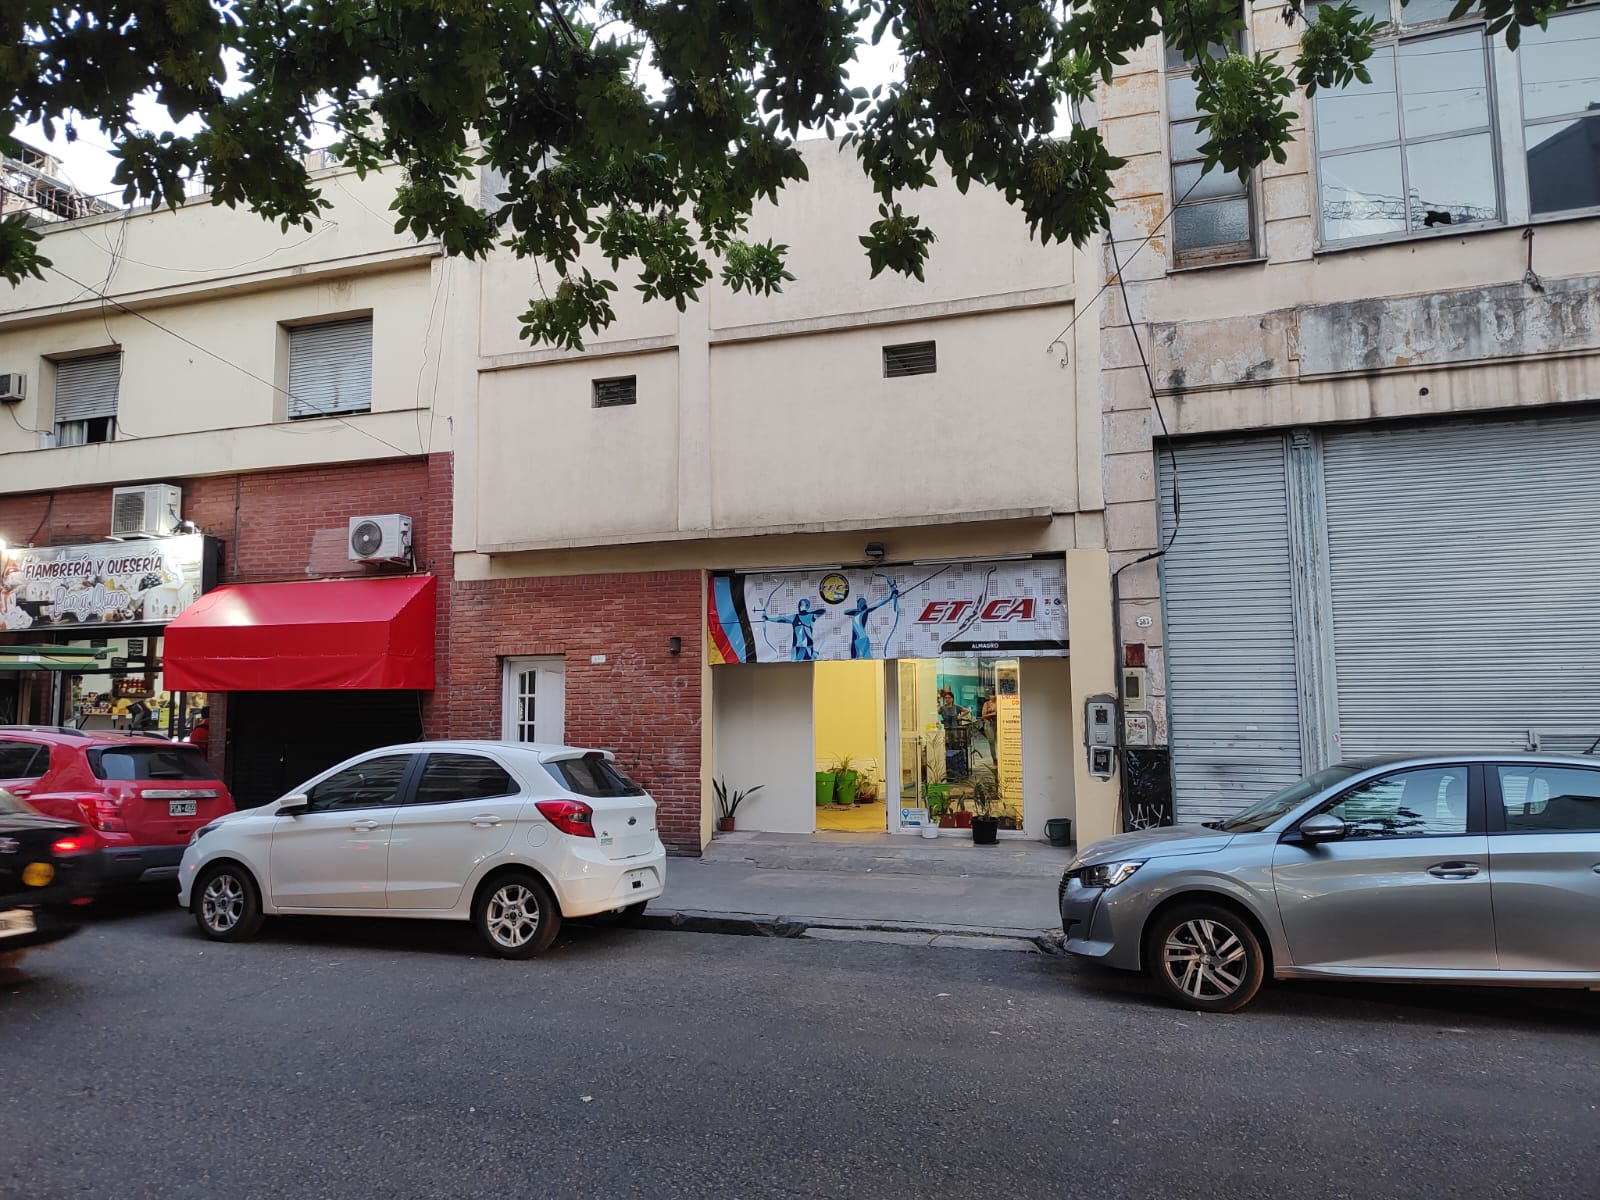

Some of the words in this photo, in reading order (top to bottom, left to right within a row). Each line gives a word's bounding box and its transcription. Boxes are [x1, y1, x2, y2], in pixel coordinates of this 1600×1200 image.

[25, 555, 92, 578] FIAMBRERÍA
[96, 560, 104, 575] Y
[107, 551, 162, 574] QUESERÍA
[92, 584, 129, 613] Queso
